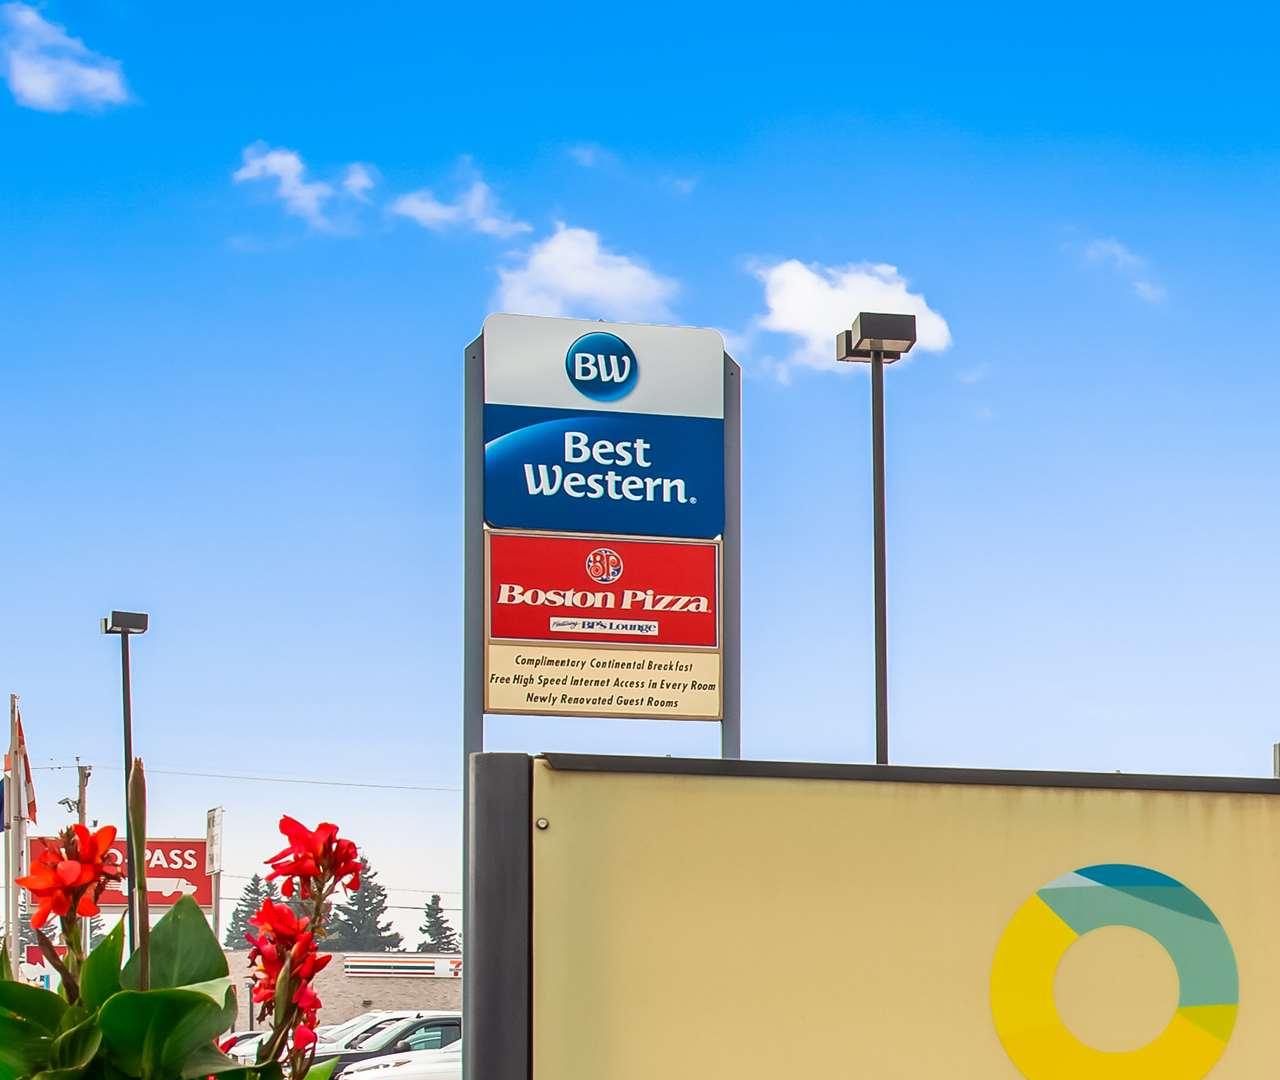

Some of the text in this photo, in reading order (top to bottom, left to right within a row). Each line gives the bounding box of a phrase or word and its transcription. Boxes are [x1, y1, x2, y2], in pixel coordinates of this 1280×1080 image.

[574, 352, 631, 383] BW
[564, 431, 652, 469] Best
[523, 463, 688, 504] Western
[589, 552, 620, 579] BP
[497, 583, 709, 614] Boston Pizza
[608, 621, 657, 633] Lounge
[515, 654, 693, 672] Complimentary Continental Breakfast
[489, 673, 716, 693] Free High Speed Internet Access in Every Room
[526, 692, 679, 708] Newly Renovated Guest Rooms
